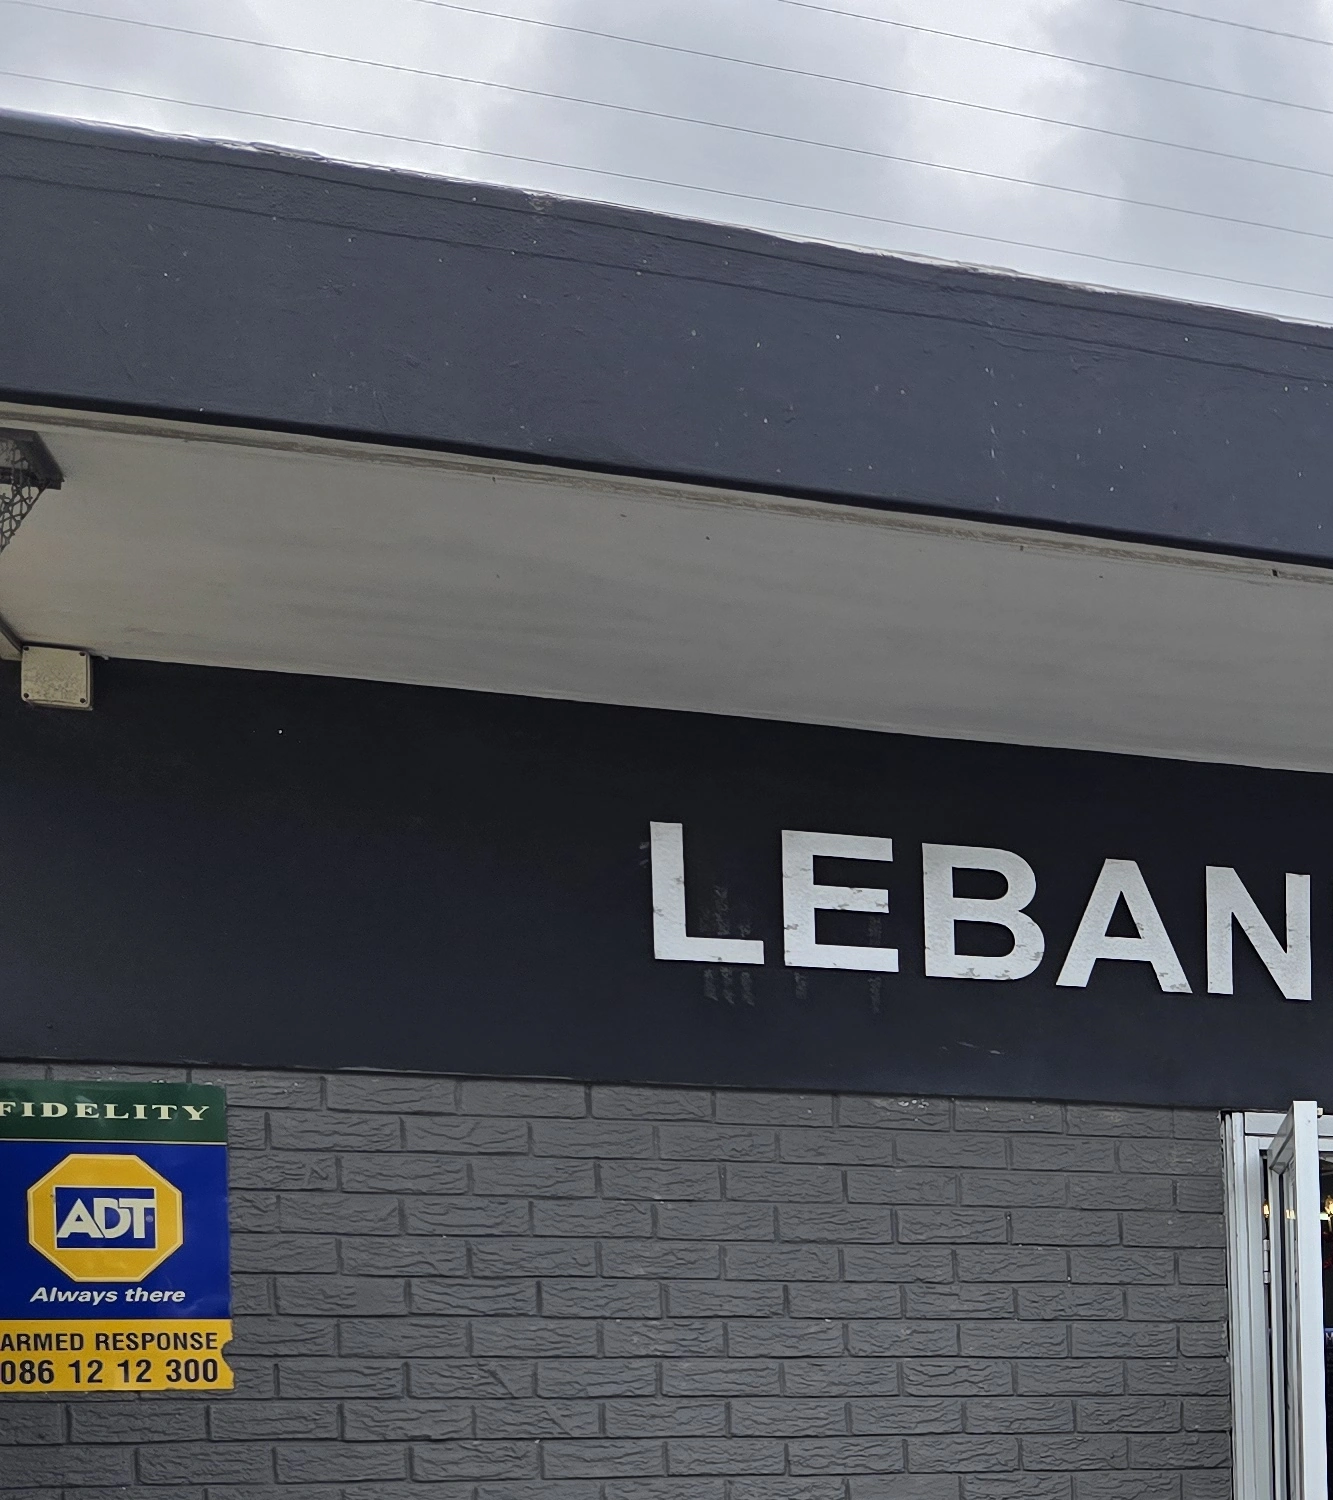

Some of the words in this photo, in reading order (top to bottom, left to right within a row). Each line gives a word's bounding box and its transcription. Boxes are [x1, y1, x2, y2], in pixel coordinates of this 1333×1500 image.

[0, 1101, 209, 1121] FIDELITY
[57, 1198, 155, 1239] ADT
[30, 1287, 118, 1306] Always
[125, 1287, 186, 1303] there
[1, 1333, 84, 1352] ARMED
[95, 1332, 218, 1351] RESPONSE
[1, 1360, 54, 1385] 086
[69, 1360, 103, 1384] 12
[118, 1359, 152, 1383] 12
[165, 1359, 218, 1383] 300
